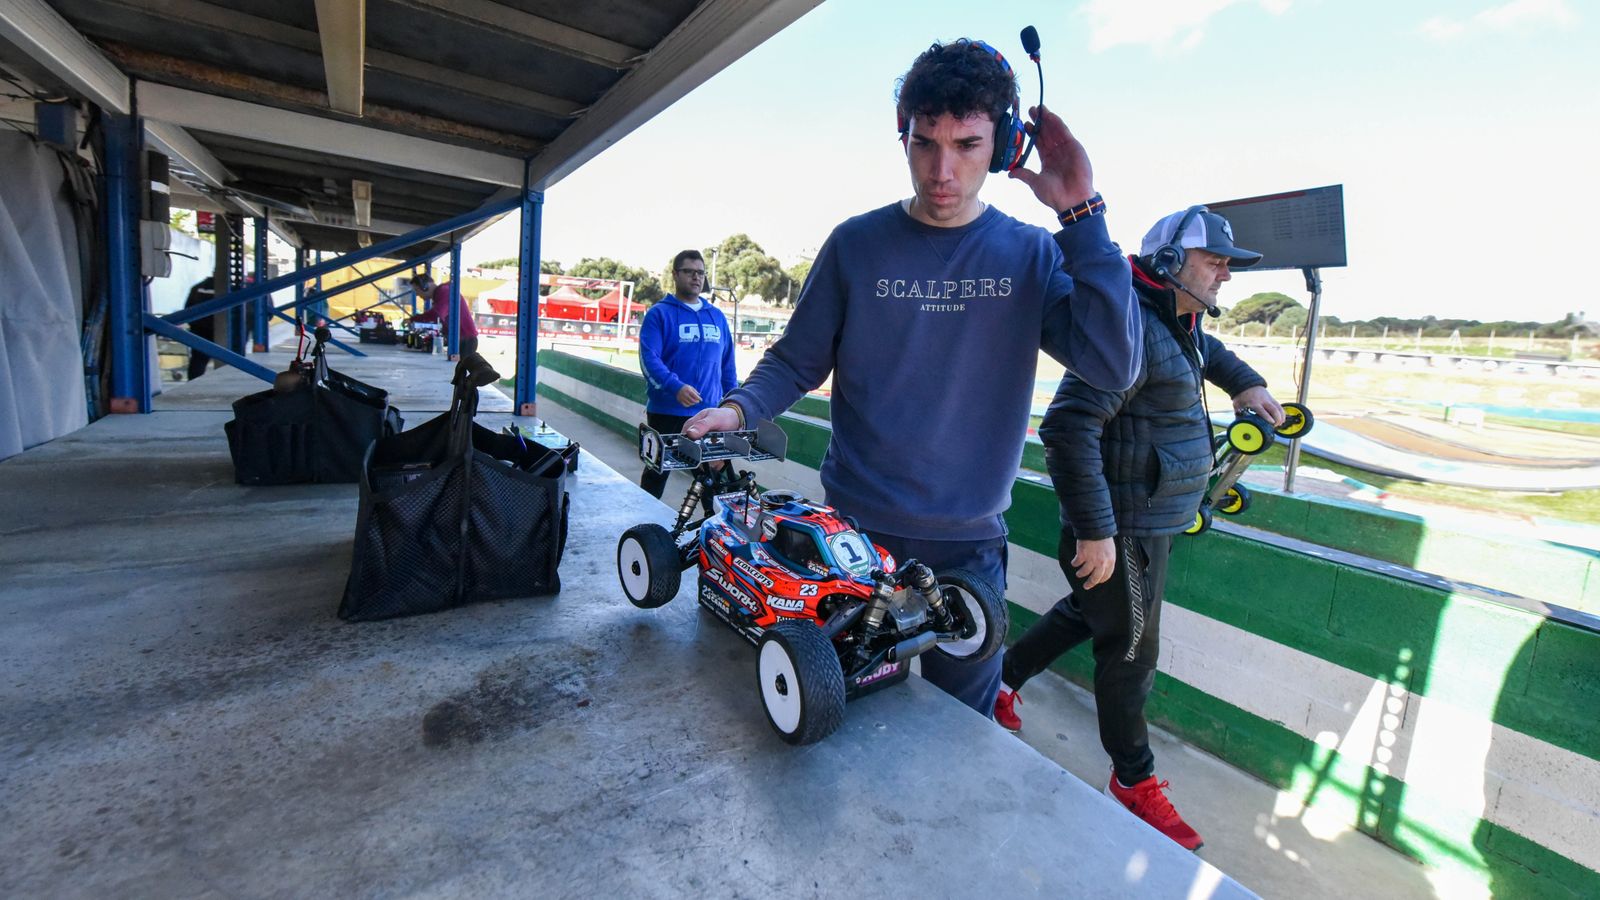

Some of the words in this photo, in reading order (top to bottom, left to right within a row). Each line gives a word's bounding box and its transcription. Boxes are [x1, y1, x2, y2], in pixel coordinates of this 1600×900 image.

[876, 277, 1012, 299] SCALPERS
[920, 304, 966, 312] ATTITUDE
[645, 437, 655, 460] 1
[840, 541, 863, 564] 1
[734, 558, 774, 588] JCONCEPTS
[800, 584, 819, 596] 23
[766, 594, 805, 609] KANA
